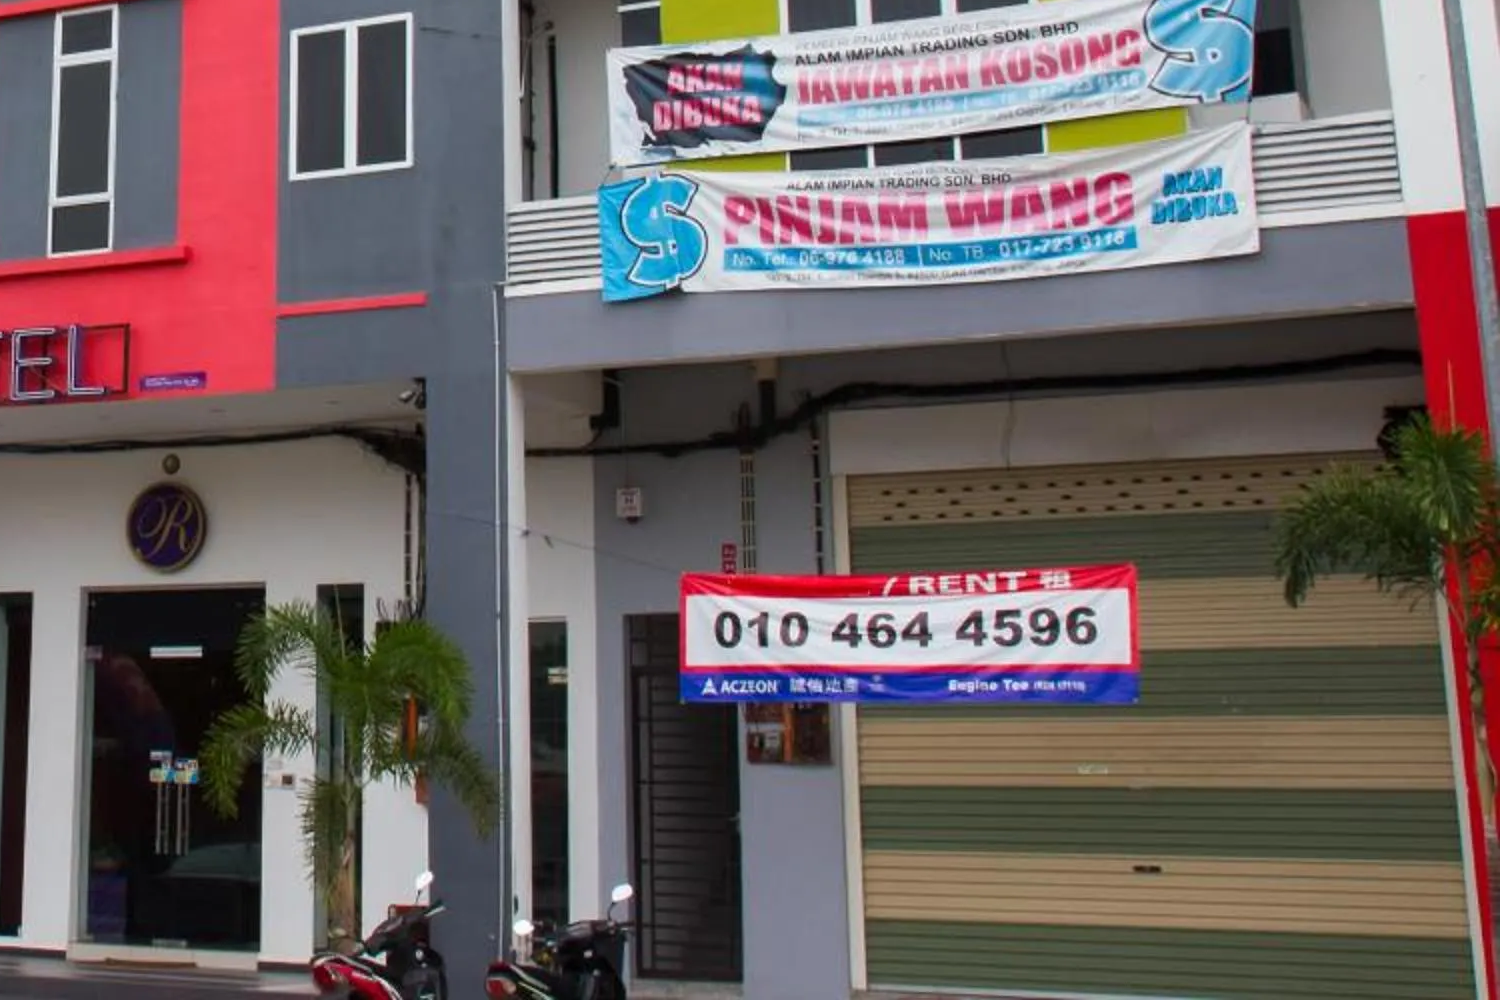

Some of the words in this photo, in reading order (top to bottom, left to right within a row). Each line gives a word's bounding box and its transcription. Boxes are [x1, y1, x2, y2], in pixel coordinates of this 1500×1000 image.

[795, 50, 841, 66] ALAM
[845, 44, 904, 61] IMPIAN
[912, 34, 988, 55] TRADING
[1040, 21, 1079, 38] BHD
[979, 28, 1142, 87] KOSONG
[667, 63, 743, 95] AKAN
[653, 95, 763, 133] DIBUKA
[786, 179, 825, 192] ALAM
[828, 178, 875, 190] IMPIAN
[879, 177, 940, 189] TRADING
[981, 173, 1012, 185] BHD
[1162, 166, 1223, 197] AKAN
[723, 191, 929, 245] PINJAM
[944, 171, 1135, 237] WANG
[1151, 191, 1239, 225] DIBUKA
[909, 571, 1027, 595] RENT
[714, 611, 810, 648] 010
[831, 611, 933, 648] 464
[955, 606, 1098, 647] 4596
[720, 678, 778, 694] ACZEON
[1002, 678, 1030, 691] Tee
